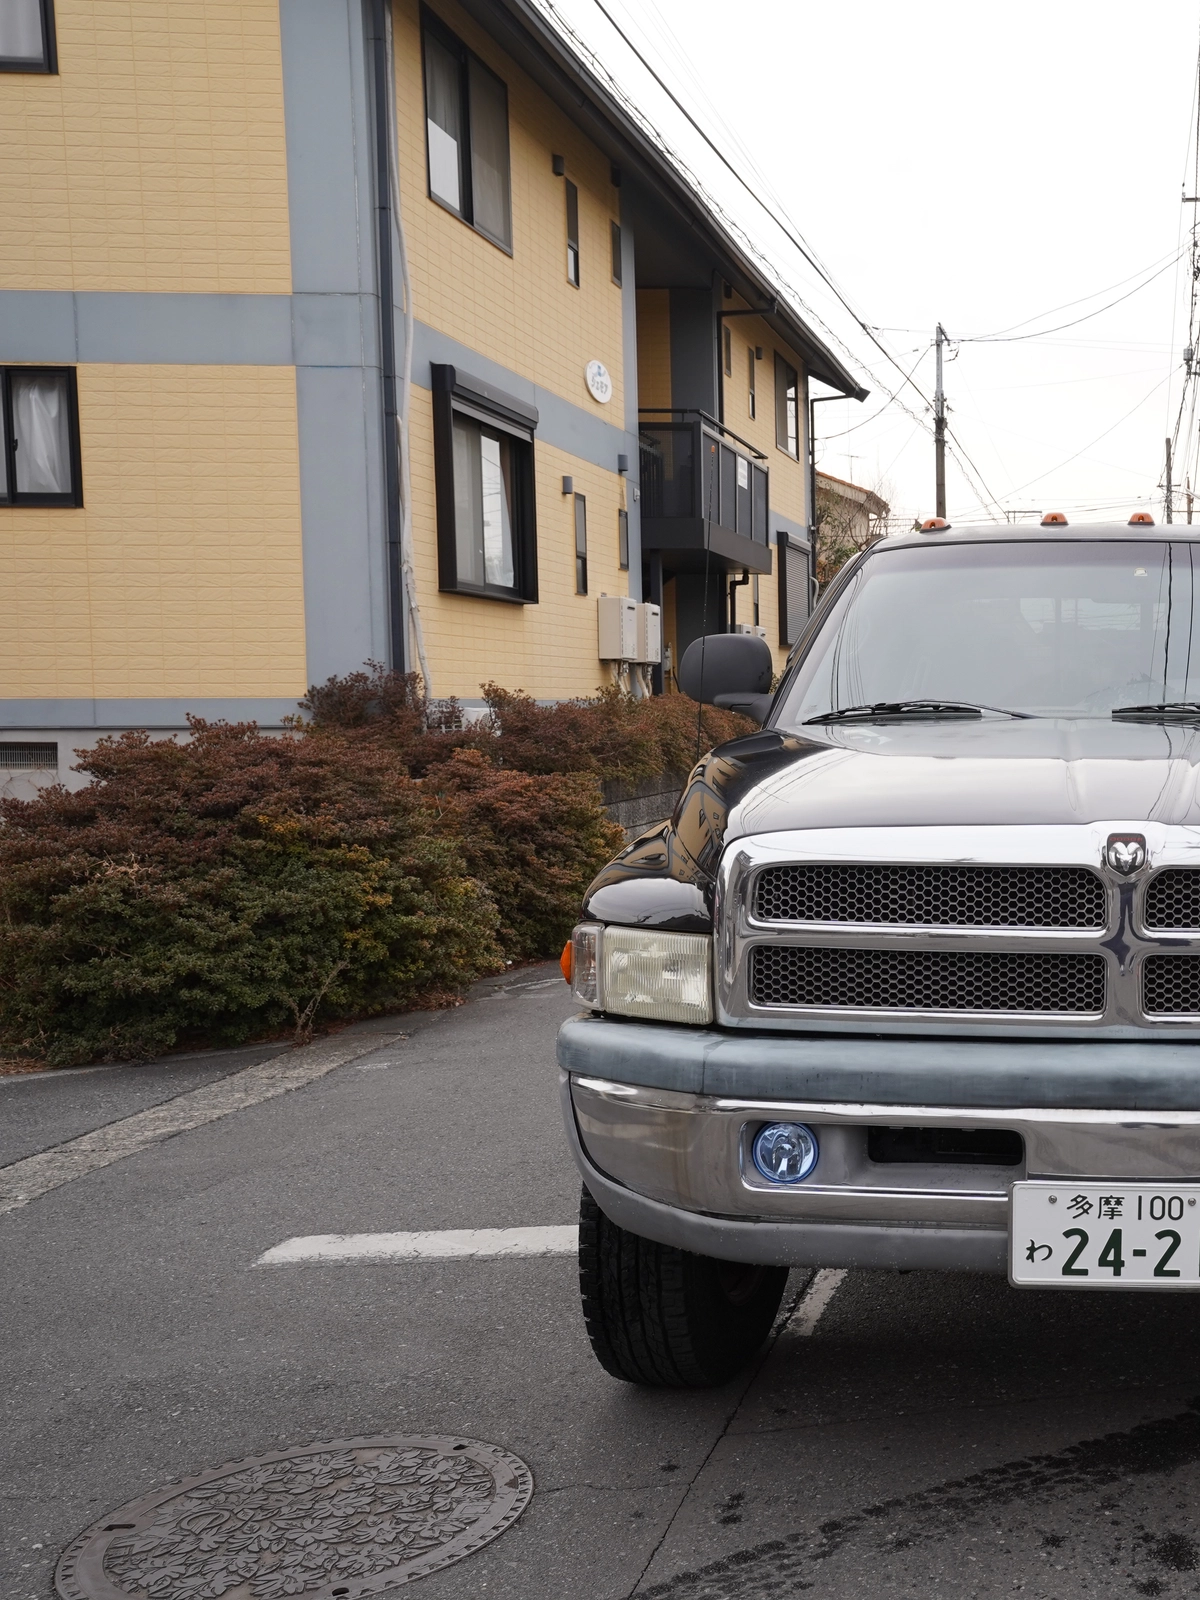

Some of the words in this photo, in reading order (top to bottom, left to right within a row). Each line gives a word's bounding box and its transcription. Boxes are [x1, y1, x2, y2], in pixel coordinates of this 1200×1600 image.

[1066, 1194, 1125, 1220] 多摩
[1137, 1195, 1184, 1221] 100
[1025, 1239, 1053, 1263] わ
